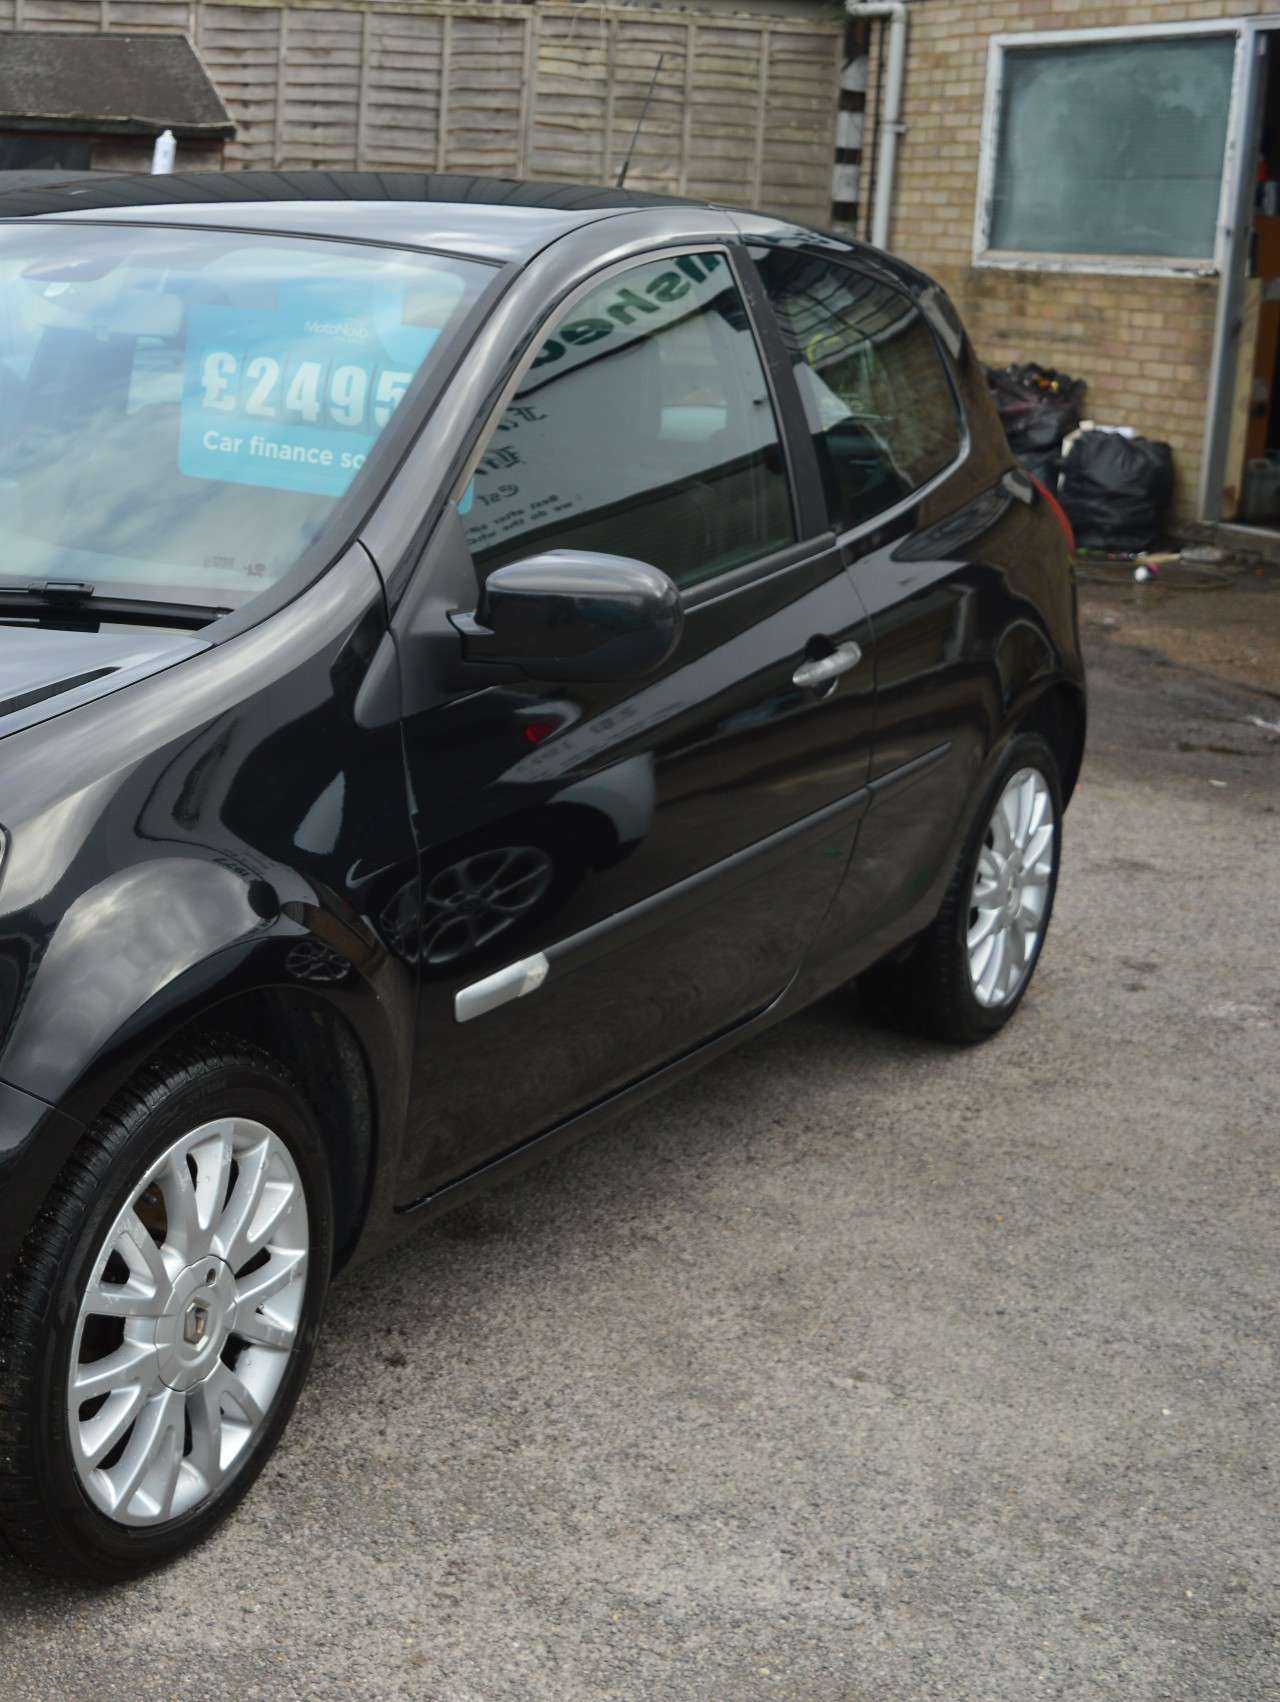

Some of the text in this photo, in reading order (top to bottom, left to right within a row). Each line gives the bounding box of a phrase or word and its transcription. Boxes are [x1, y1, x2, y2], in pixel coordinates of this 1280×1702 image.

[201, 351, 413, 428] £2495
[202, 430, 243, 452] Car
[248, 435, 334, 466] finance
